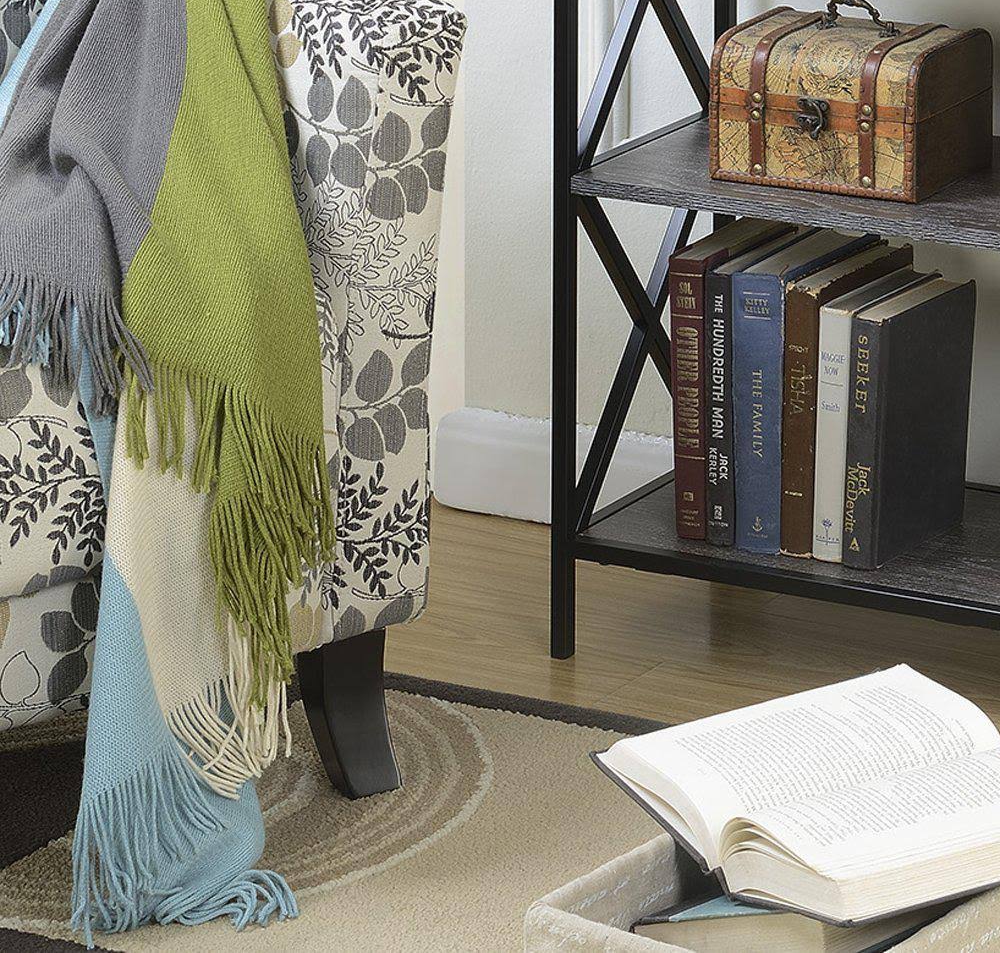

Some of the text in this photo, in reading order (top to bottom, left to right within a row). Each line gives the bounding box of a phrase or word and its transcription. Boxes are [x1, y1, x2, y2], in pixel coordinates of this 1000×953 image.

[676, 326, 700, 448] OTHER PEOPLE
[711, 294, 725, 439] THE HUNDREDTH MAN
[752, 369, 763, 458] THE FAMILY
[708, 447, 718, 486] KERLEY
[719, 453, 728, 480] JACK
[844, 466, 860, 534] McDevitt
[857, 462, 872, 496] Jack
